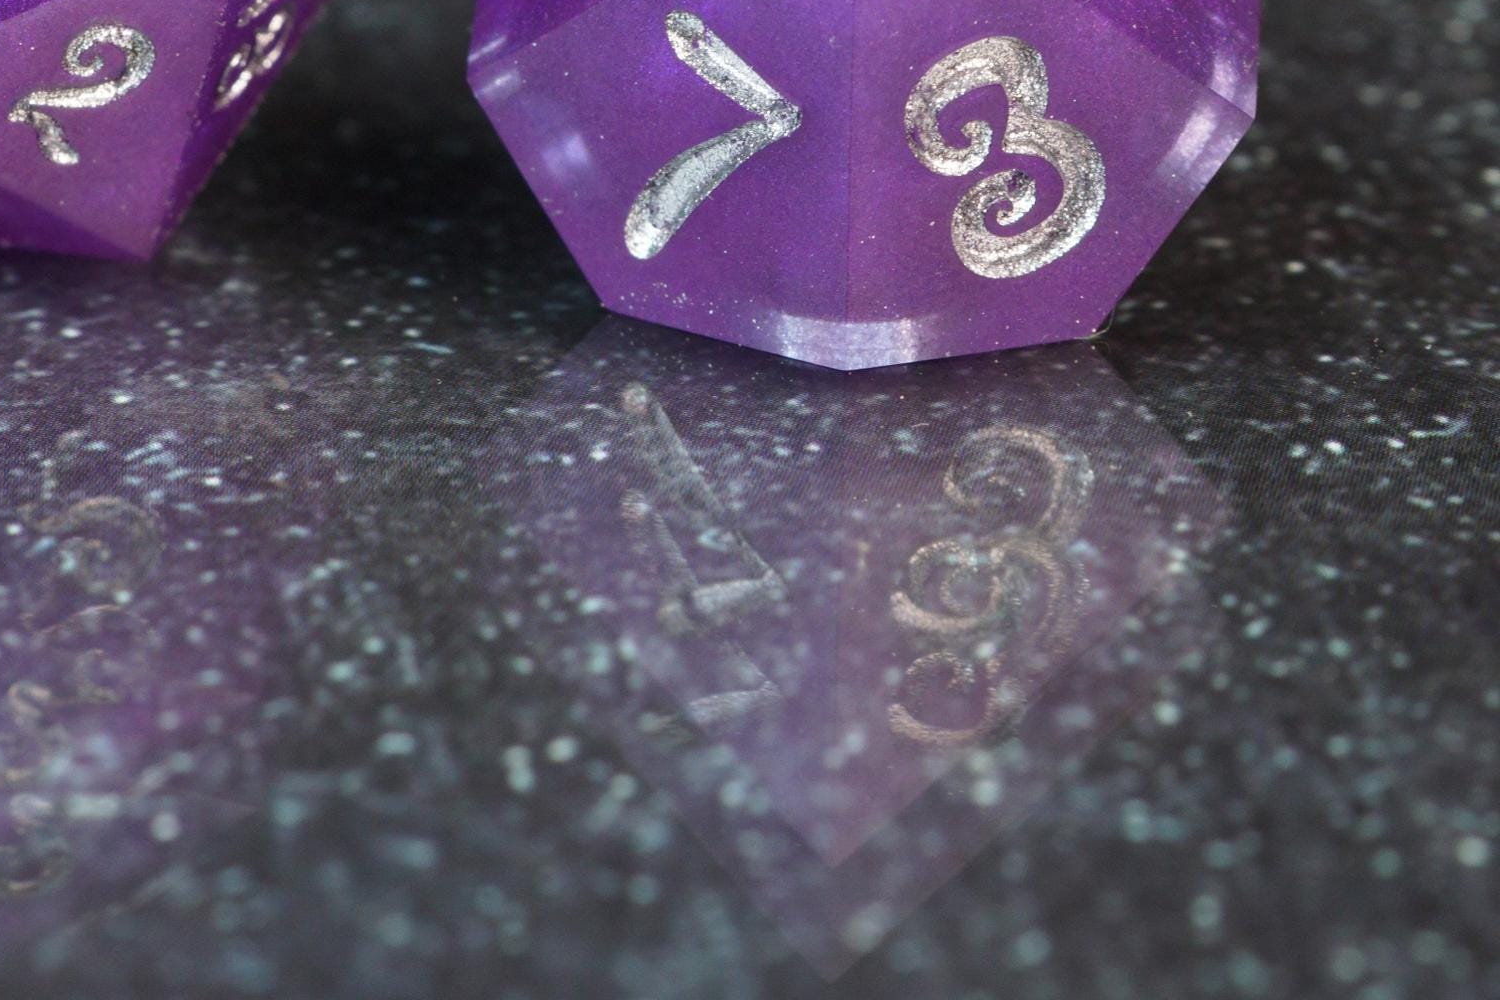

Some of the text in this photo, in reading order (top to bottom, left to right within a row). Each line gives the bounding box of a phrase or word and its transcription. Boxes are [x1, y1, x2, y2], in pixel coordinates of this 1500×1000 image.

[8, 22, 156, 165] 2
[624, 10, 803, 260] 7
[905, 35, 1105, 279] 3
